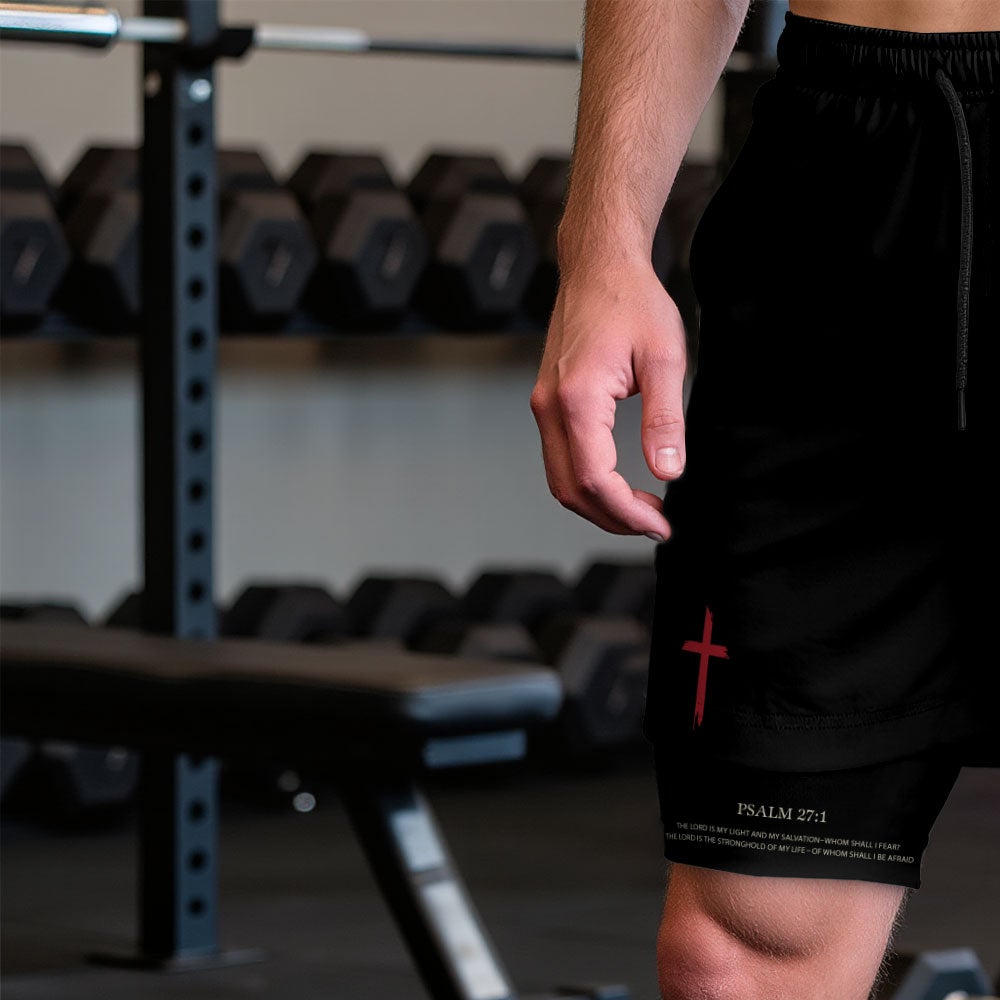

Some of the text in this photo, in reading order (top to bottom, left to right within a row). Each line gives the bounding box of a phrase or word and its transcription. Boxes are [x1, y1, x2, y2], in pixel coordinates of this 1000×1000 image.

[737, 802, 827, 823] PSALM 27:1
[665, 832, 678, 840] THE
[678, 833, 696, 842] LORD
[704, 835, 717, 844] THE
[717, 837, 766, 850] STRONGHOLD
[767, 843, 778, 851] OF
[779, 844, 791, 852] MY
[823, 848, 848, 858] WHOM
[849, 850, 873, 860] SHALL
[877, 853, 887, 861] BE
[887, 855, 915, 864] AFRAID
[676, 822, 689, 830] THE
[690, 823, 708, 832] LORD
[709, 825, 716, 833] IS
[716, 826, 728, 834] MY
[729, 828, 750, 837] LIGHT
[750, 830, 768, 839] AND
[768, 832, 780, 841] MY
[850, 840, 873, 849] SHALL
